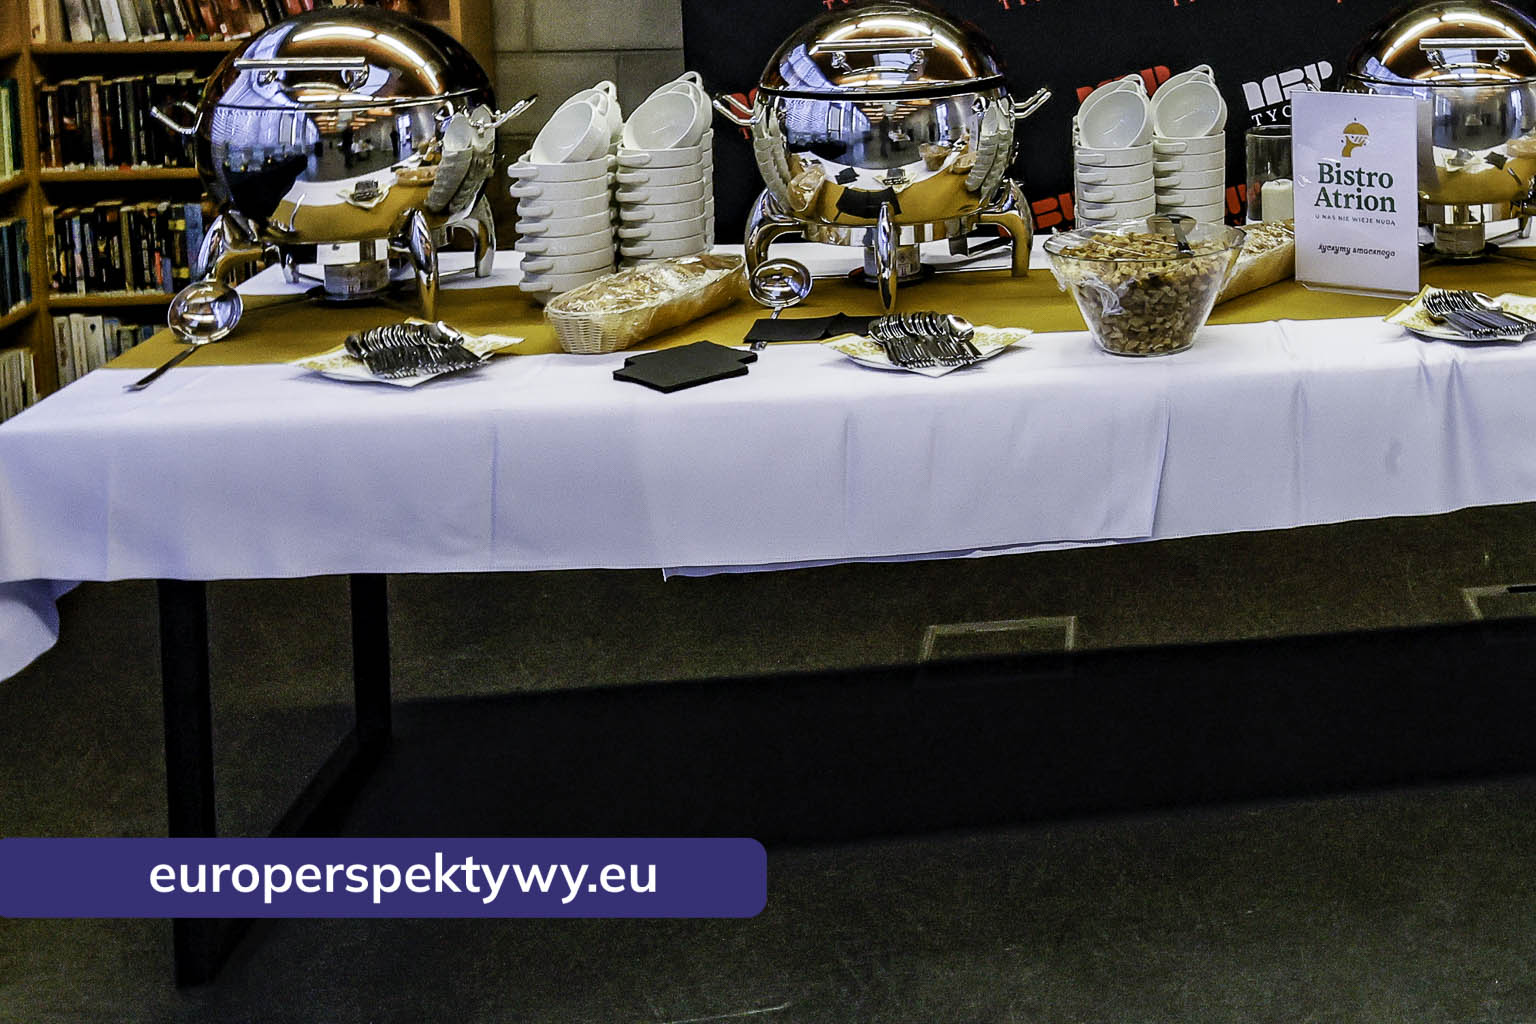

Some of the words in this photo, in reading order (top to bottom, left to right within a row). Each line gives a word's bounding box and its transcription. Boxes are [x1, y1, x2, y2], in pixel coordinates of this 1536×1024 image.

[1251, 105, 1291, 126] TYC
[1317, 162, 1394, 189] Bistro
[1314, 186, 1397, 213] Atrion
